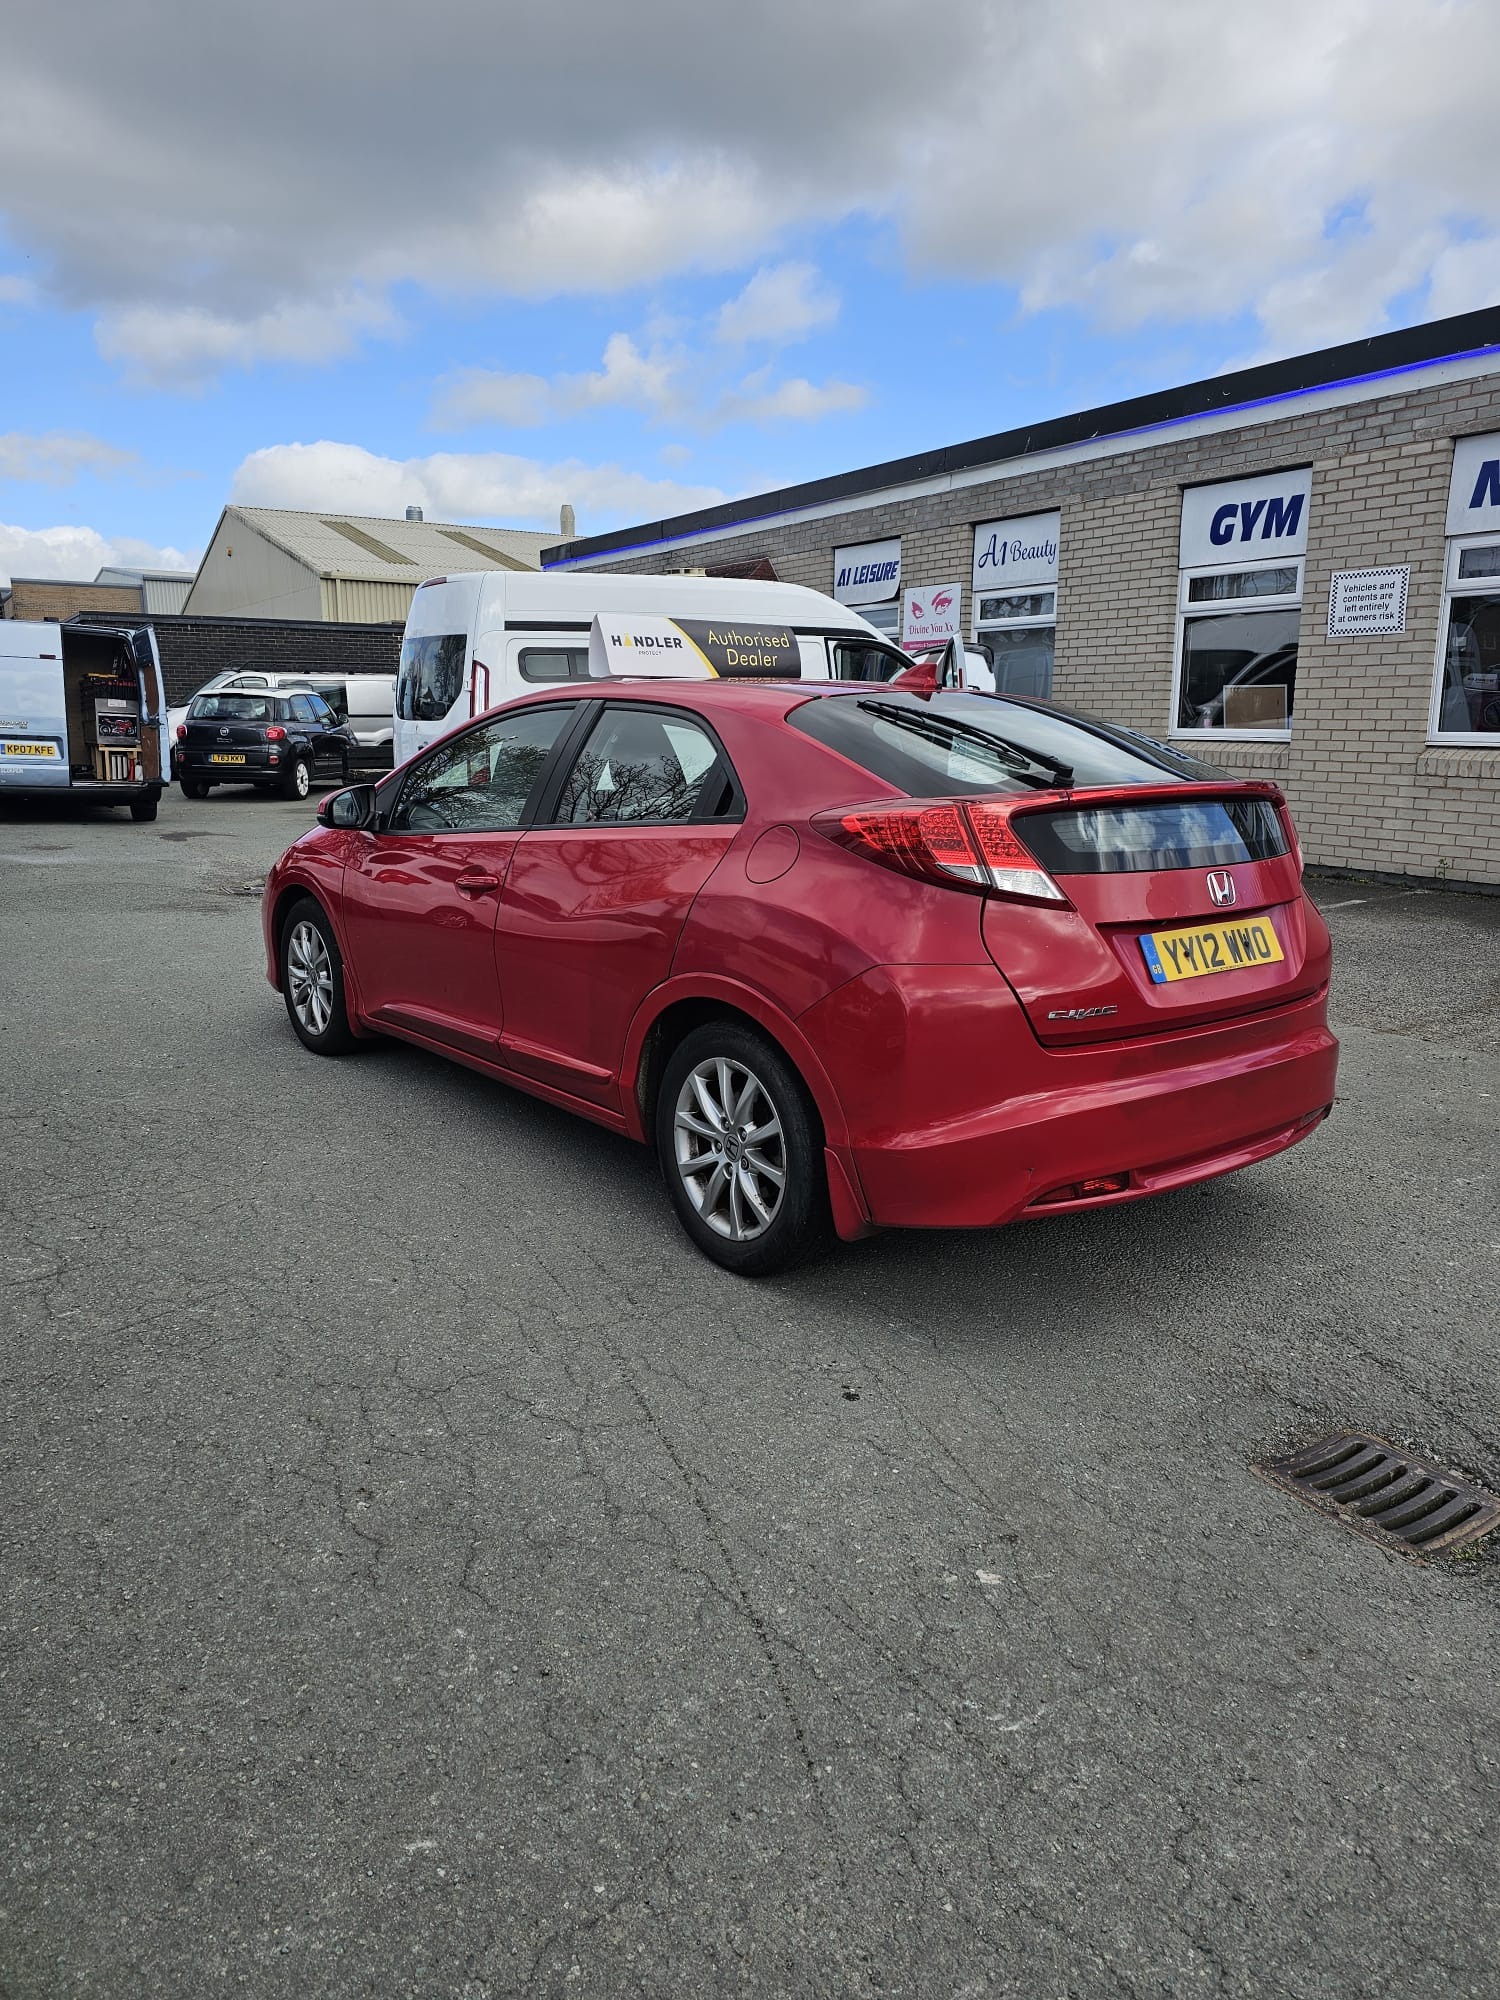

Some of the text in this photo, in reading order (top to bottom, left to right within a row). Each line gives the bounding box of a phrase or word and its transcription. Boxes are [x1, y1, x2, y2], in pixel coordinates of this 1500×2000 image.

[1210, 493, 1306, 546] GYM
[978, 533, 1057, 569] A1 Beauty
[853, 560, 900, 585] LEISURE
[1343, 580, 1396, 593] Vehicles and
[1342, 592, 1394, 603] contents are
[1344, 602, 1390, 613] left entirely
[1347, 613, 1377, 622] owners
[1378, 611, 1395, 620] risk
[909, 625, 930, 635] Divine
[708, 629, 790, 648] Authorised
[726, 648, 778, 668] Dealer
[6, 744, 55, 755] KP07 KFE
[1162, 926, 1272, 975] YY12 WWO
[1152, 963, 1163, 975] GB
[1048, 1004, 1118, 1020] CIVIC
